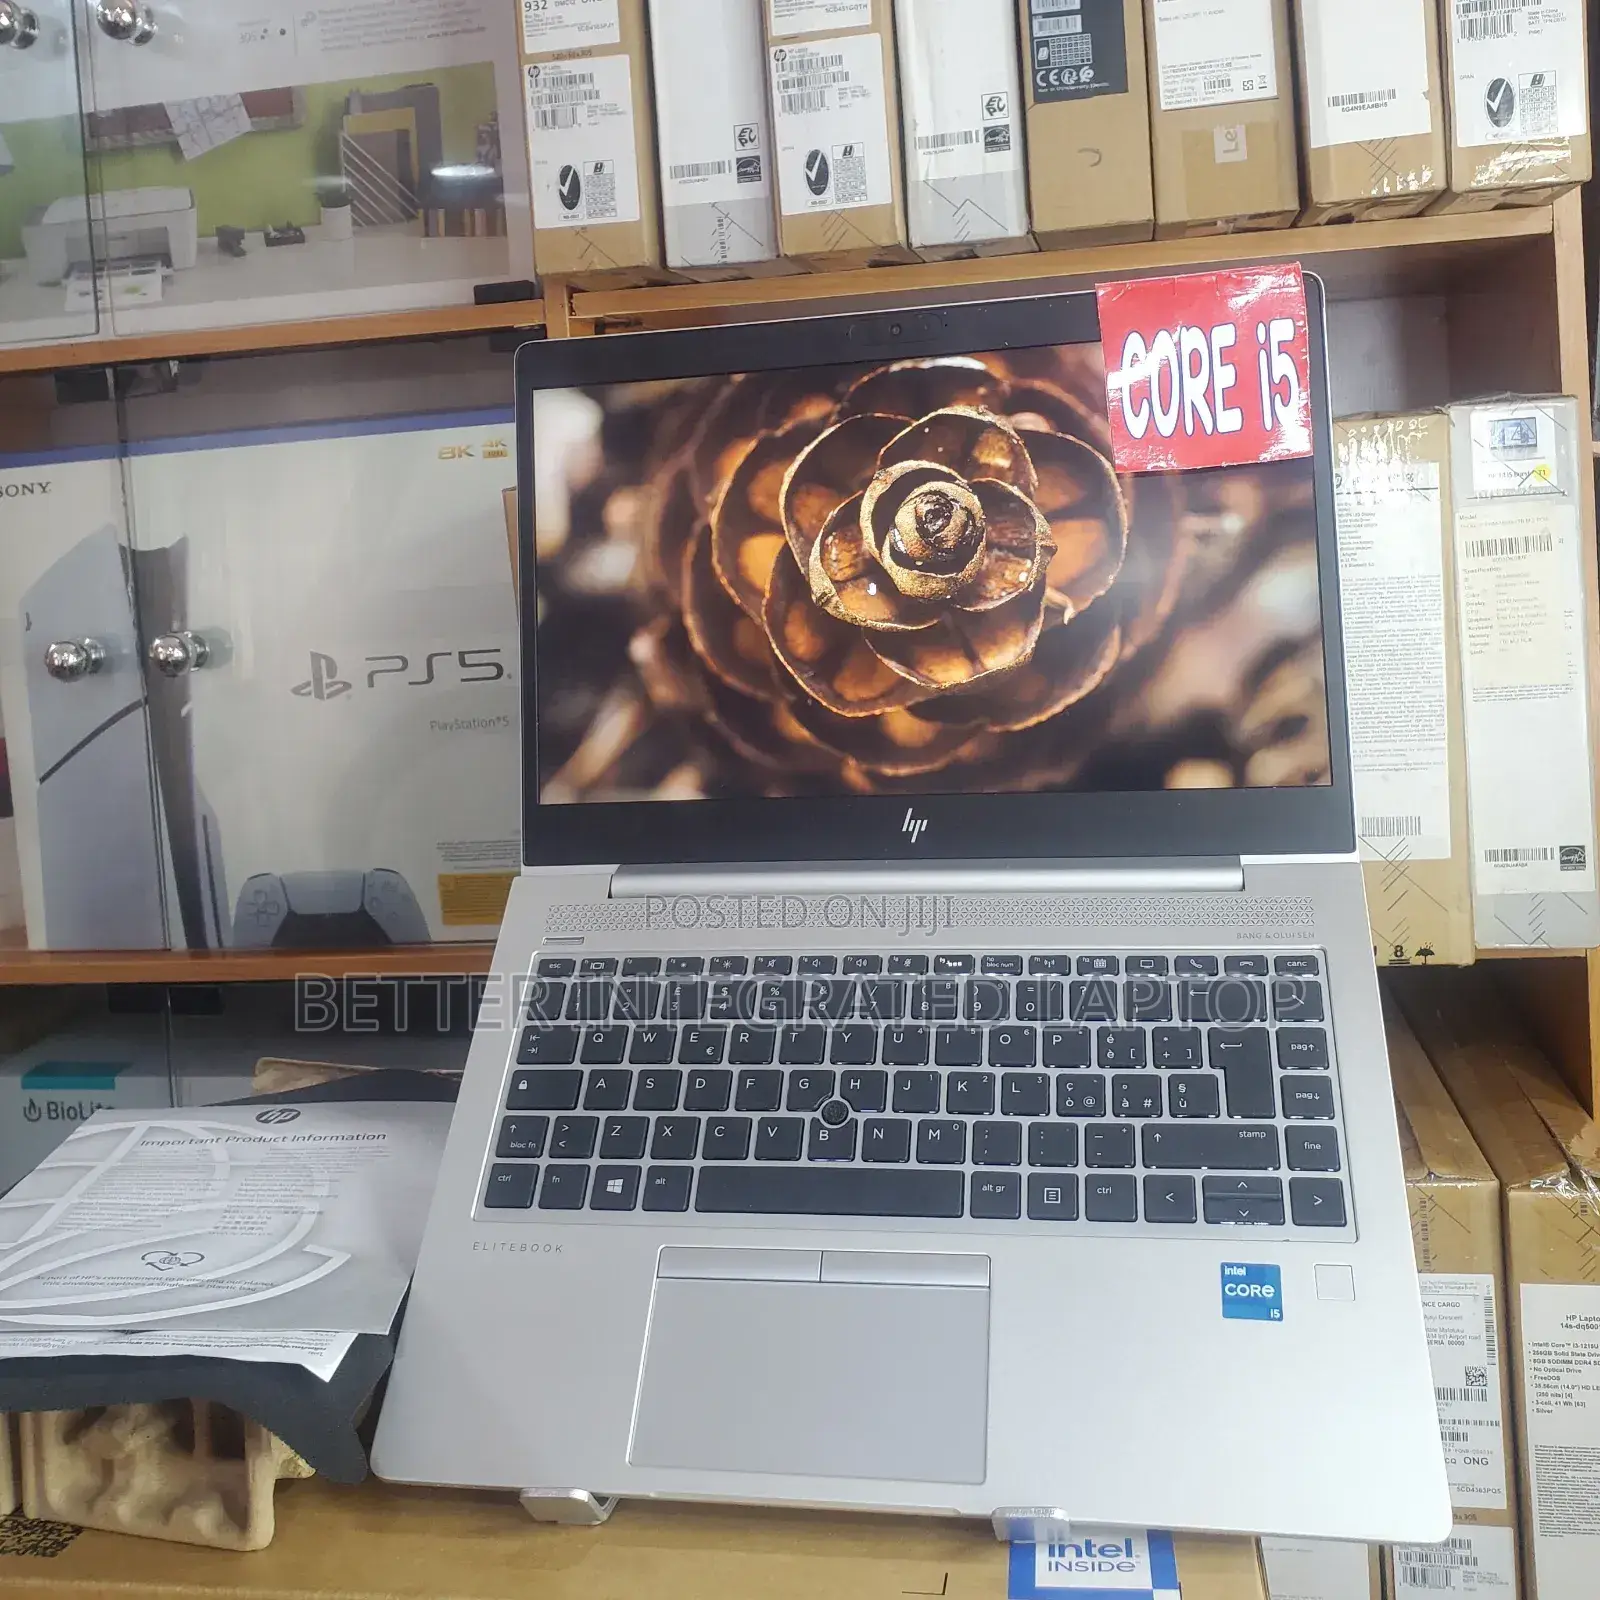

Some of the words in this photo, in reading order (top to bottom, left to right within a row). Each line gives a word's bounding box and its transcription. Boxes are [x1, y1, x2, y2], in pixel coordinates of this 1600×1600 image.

[1120, 322, 1244, 440] CORE
[1256, 318, 1301, 433] i5
[438, 445, 474, 459] 8K
[365, 648, 504, 688] PS5
[1394, 945, 1404, 957] 8
[721, 987, 728, 997] $
[770, 987, 780, 996] %
[622, 1002, 630, 1011] 2
[671, 1002, 678, 1011] 3
[719, 1002, 727, 1011] 4
[769, 1002, 776, 1011] 5
[819, 1002, 826, 1011] 6
[870, 1002, 877, 1011] 7
[921, 1002, 929, 1011] 8
[973, 1002, 981, 1012] 9
[593, 1033, 604, 1042] Q
[643, 1033, 657, 1042] W
[690, 1033, 699, 1042] E
[740, 1033, 749, 1042] R
[789, 1033, 798, 1042] T
[842, 1033, 851, 1043] Y
[893, 1033, 903, 1043] U
[1052, 1035, 1062, 1045] P
[706, 1046, 714, 1055] €
[596, 1079, 606, 1088] A
[646, 1079, 654, 1089] S
[696, 1079, 706, 1089] D
[746, 1079, 755, 1089] F
[799, 1079, 809, 1089] G
[850, 1079, 860, 1089] H
[903, 1080, 911, 1091] J
[958, 1081, 968, 1092] K
[1012, 1082, 1020, 1093] L
[1083, 1096, 1096, 1107] @
[47, 1100, 115, 1120] BioLi
[611, 1126, 621, 1136] Z
[662, 1126, 673, 1136] X
[714, 1126, 724, 1137] C
[767, 1126, 778, 1137] V
[819, 1130, 829, 1141] B
[873, 1128, 884, 1139] N
[929, 1129, 940, 1140] M
[1239, 1131, 1266, 1139] stamp
[140, 1138, 222, 1147] Important
[225, 1135, 288, 1144] Product
[292, 1132, 387, 1142] Information
[528, 1141, 536, 1149] fn
[1304, 1142, 1321, 1150] fine
[655, 1177, 666, 1185] alt
[982, 1183, 993, 1191] alt
[996, 1185, 1005, 1193] gr
[1097, 1186, 1112, 1194] ctrl
[473, 1242, 563, 1253] ELITEBOOK
[1224, 1265, 1246, 1276] intel
[1270, 1308, 1280, 1319] i5
[1464, 1456, 1489, 1466] ONG
[1048, 1537, 1133, 1559] intel
